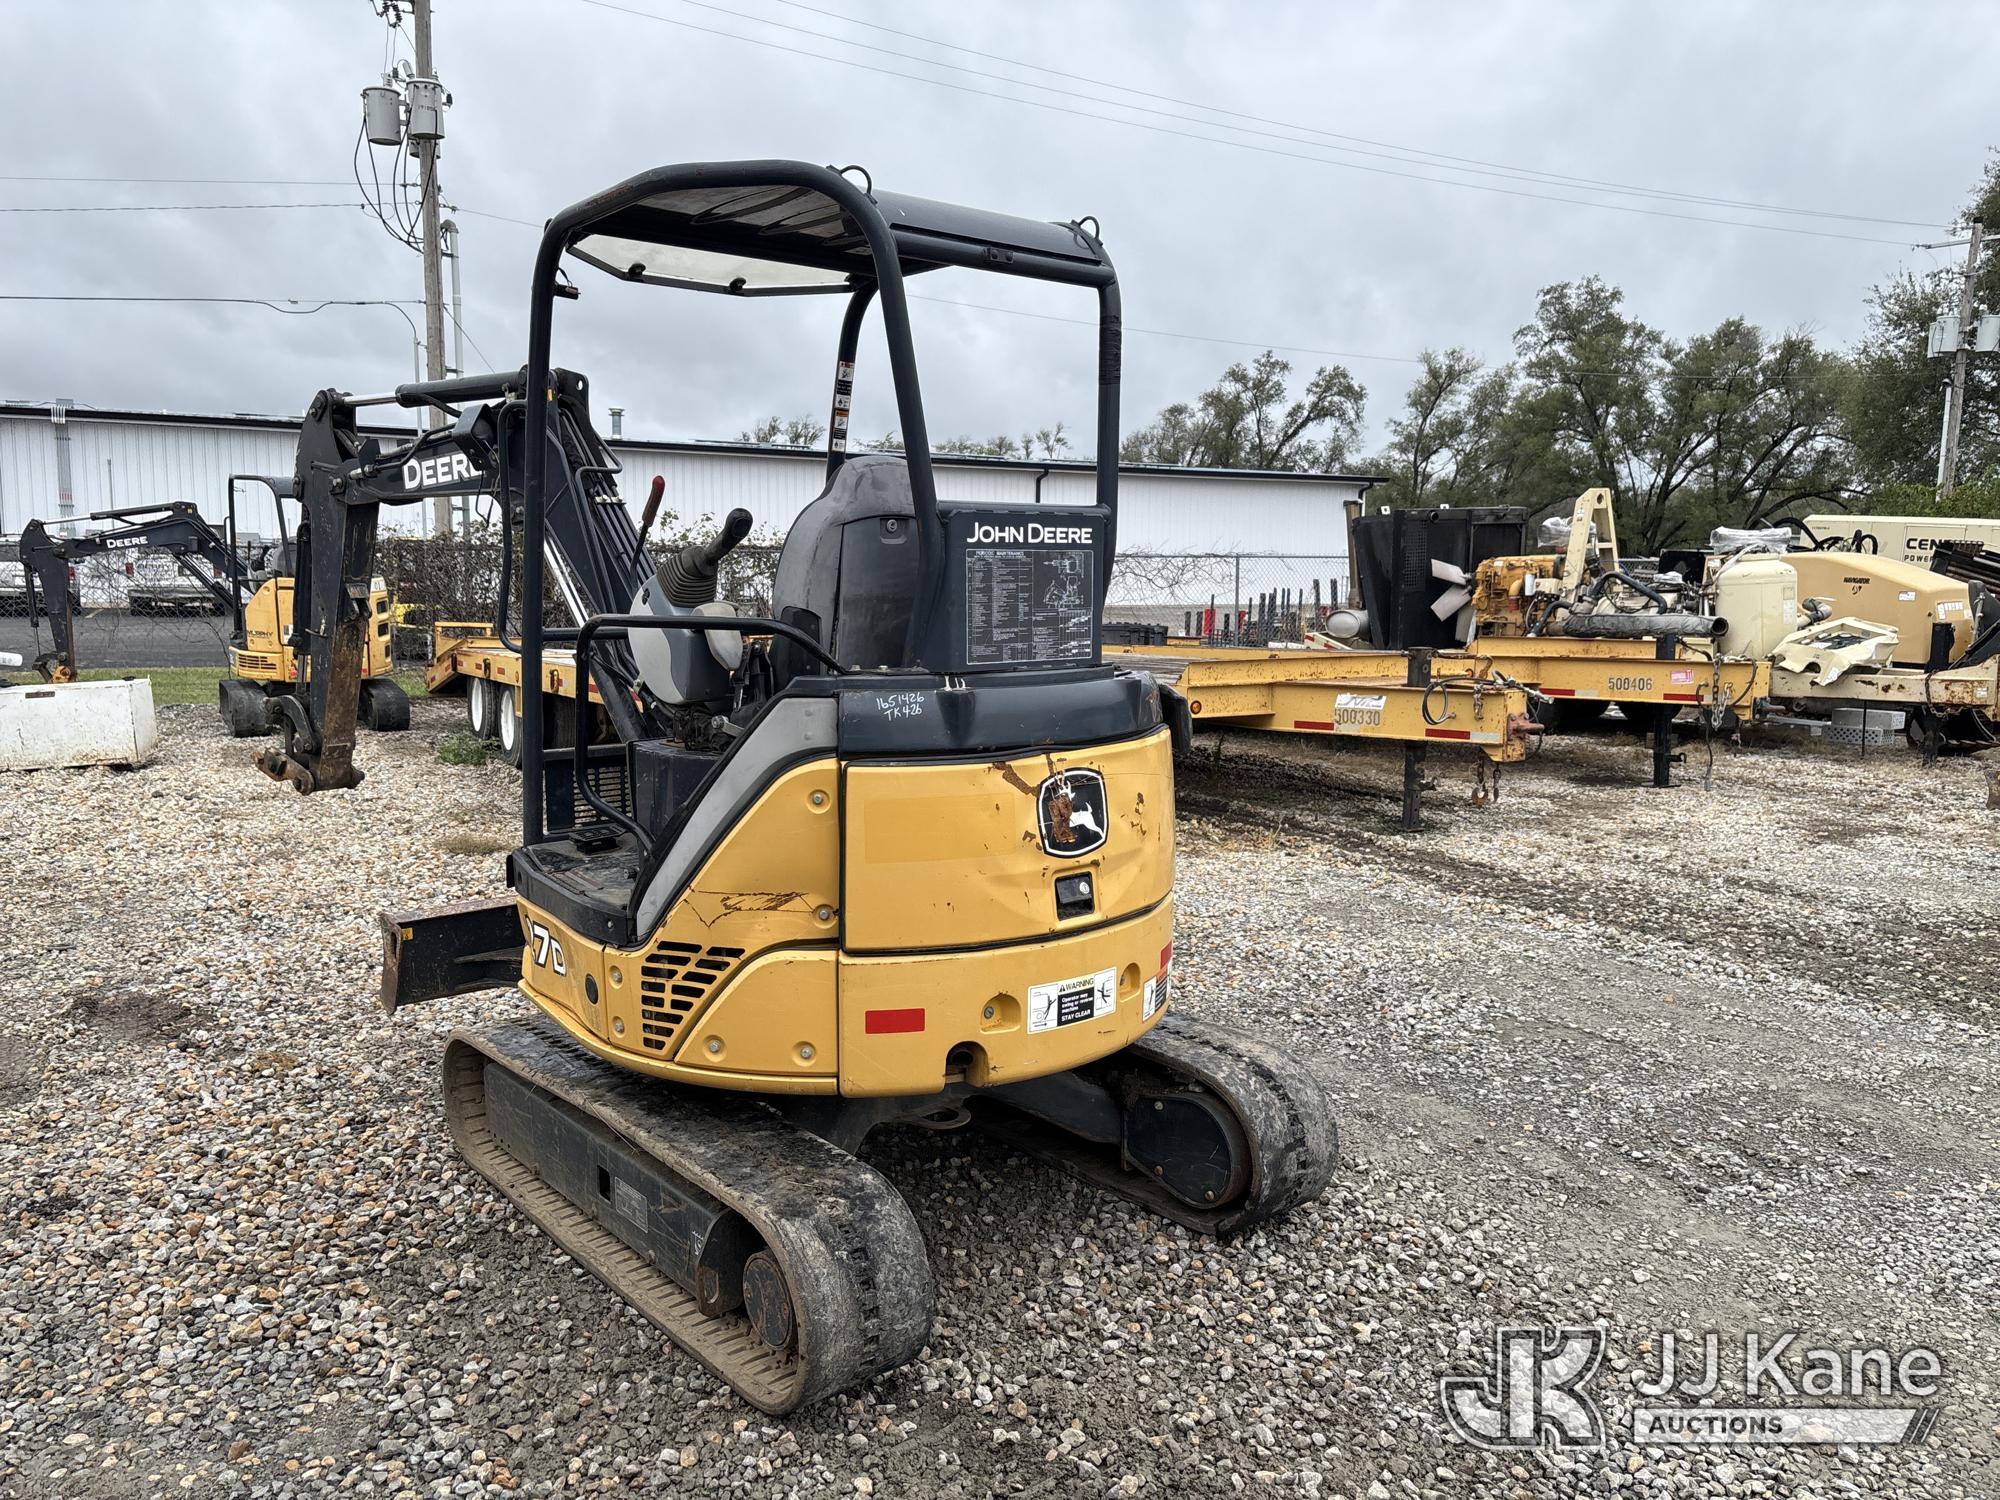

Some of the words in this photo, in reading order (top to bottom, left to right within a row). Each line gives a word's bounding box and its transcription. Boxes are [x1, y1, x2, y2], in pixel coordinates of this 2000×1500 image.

[967, 522, 1024, 543] JOHN
[1028, 523, 1092, 543] DEERE
[106, 536, 148, 548] DEERE
[1608, 677, 1653, 691] 500406
[876, 692, 924, 710] 1651426
[1065, 978, 1094, 990] WARNING
[1061, 1013, 1074, 1022] STAY
[1074, 1009, 1091, 1018] CLEAR
